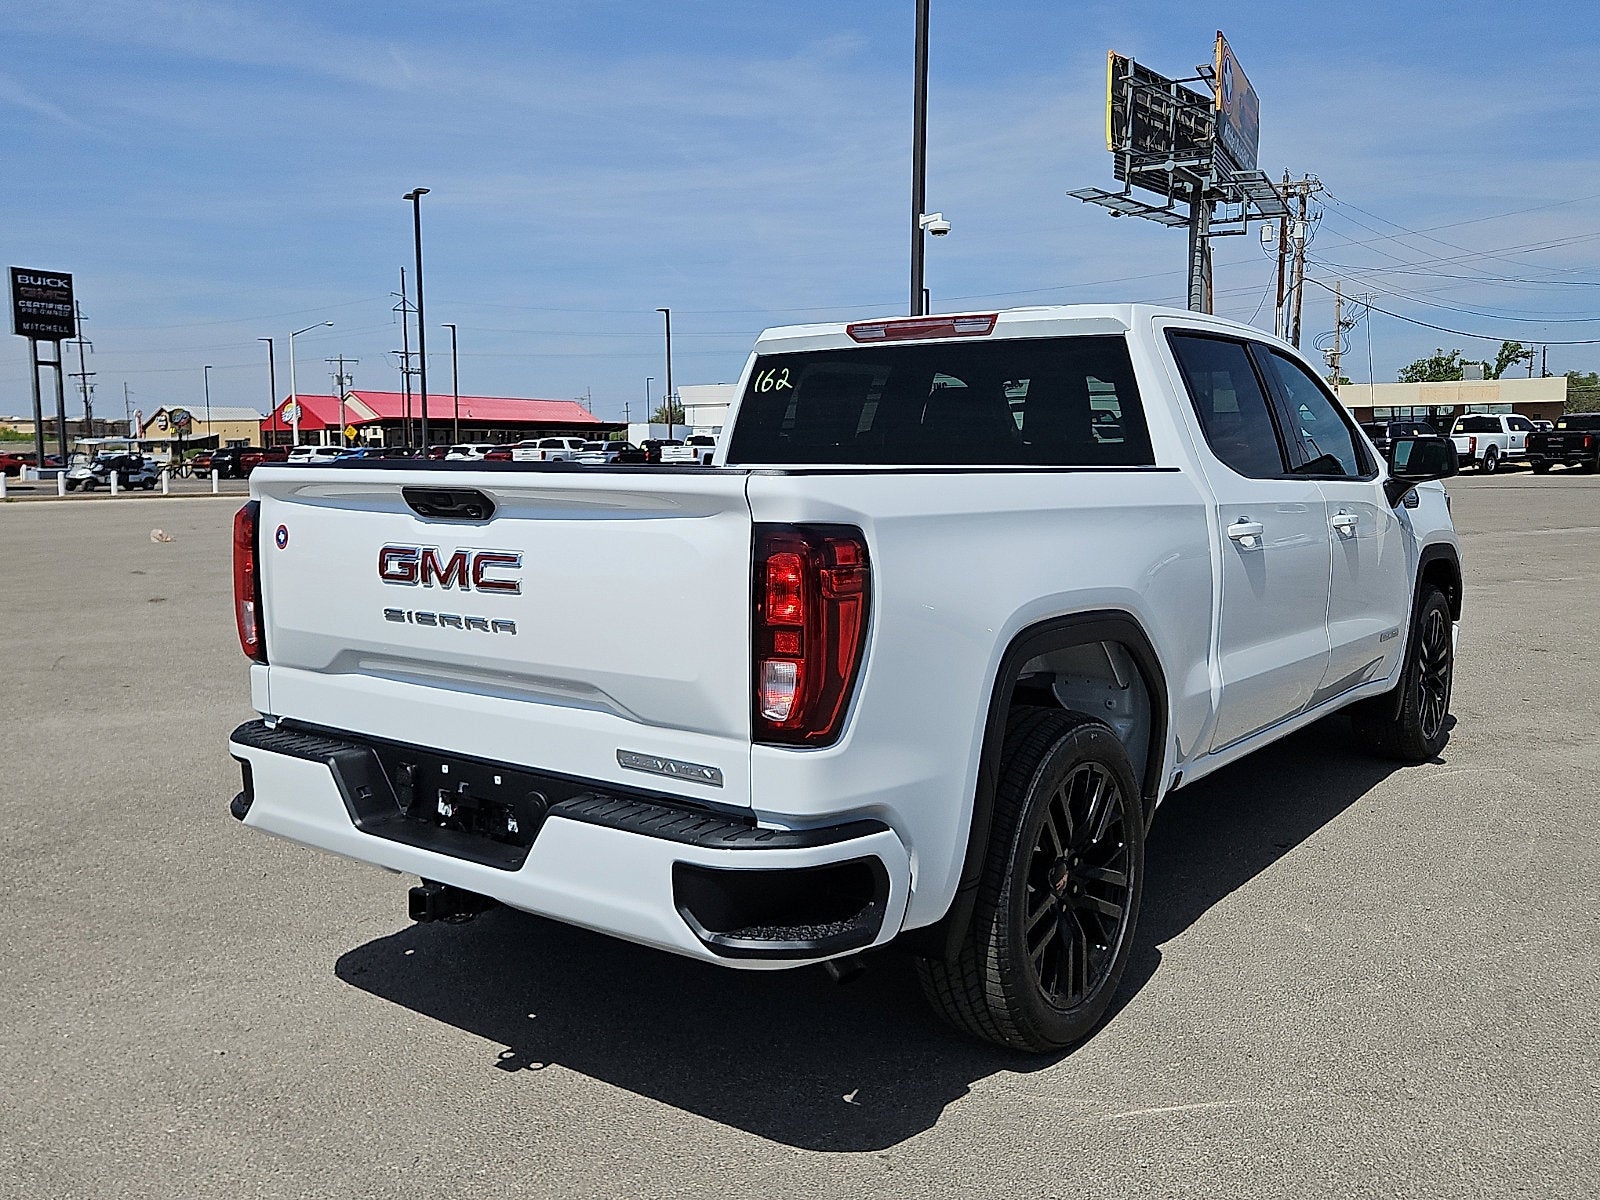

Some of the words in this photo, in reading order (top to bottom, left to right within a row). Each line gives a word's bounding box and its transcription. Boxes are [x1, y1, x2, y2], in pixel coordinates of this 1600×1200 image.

[17, 275, 70, 288] BUICK
[18, 300, 71, 311] CERTIFIED
[22, 322, 69, 333] MITCHELL
[754, 367, 793, 392] 162
[378, 543, 523, 596] GMC
[383, 607, 517, 635] SIERRA
